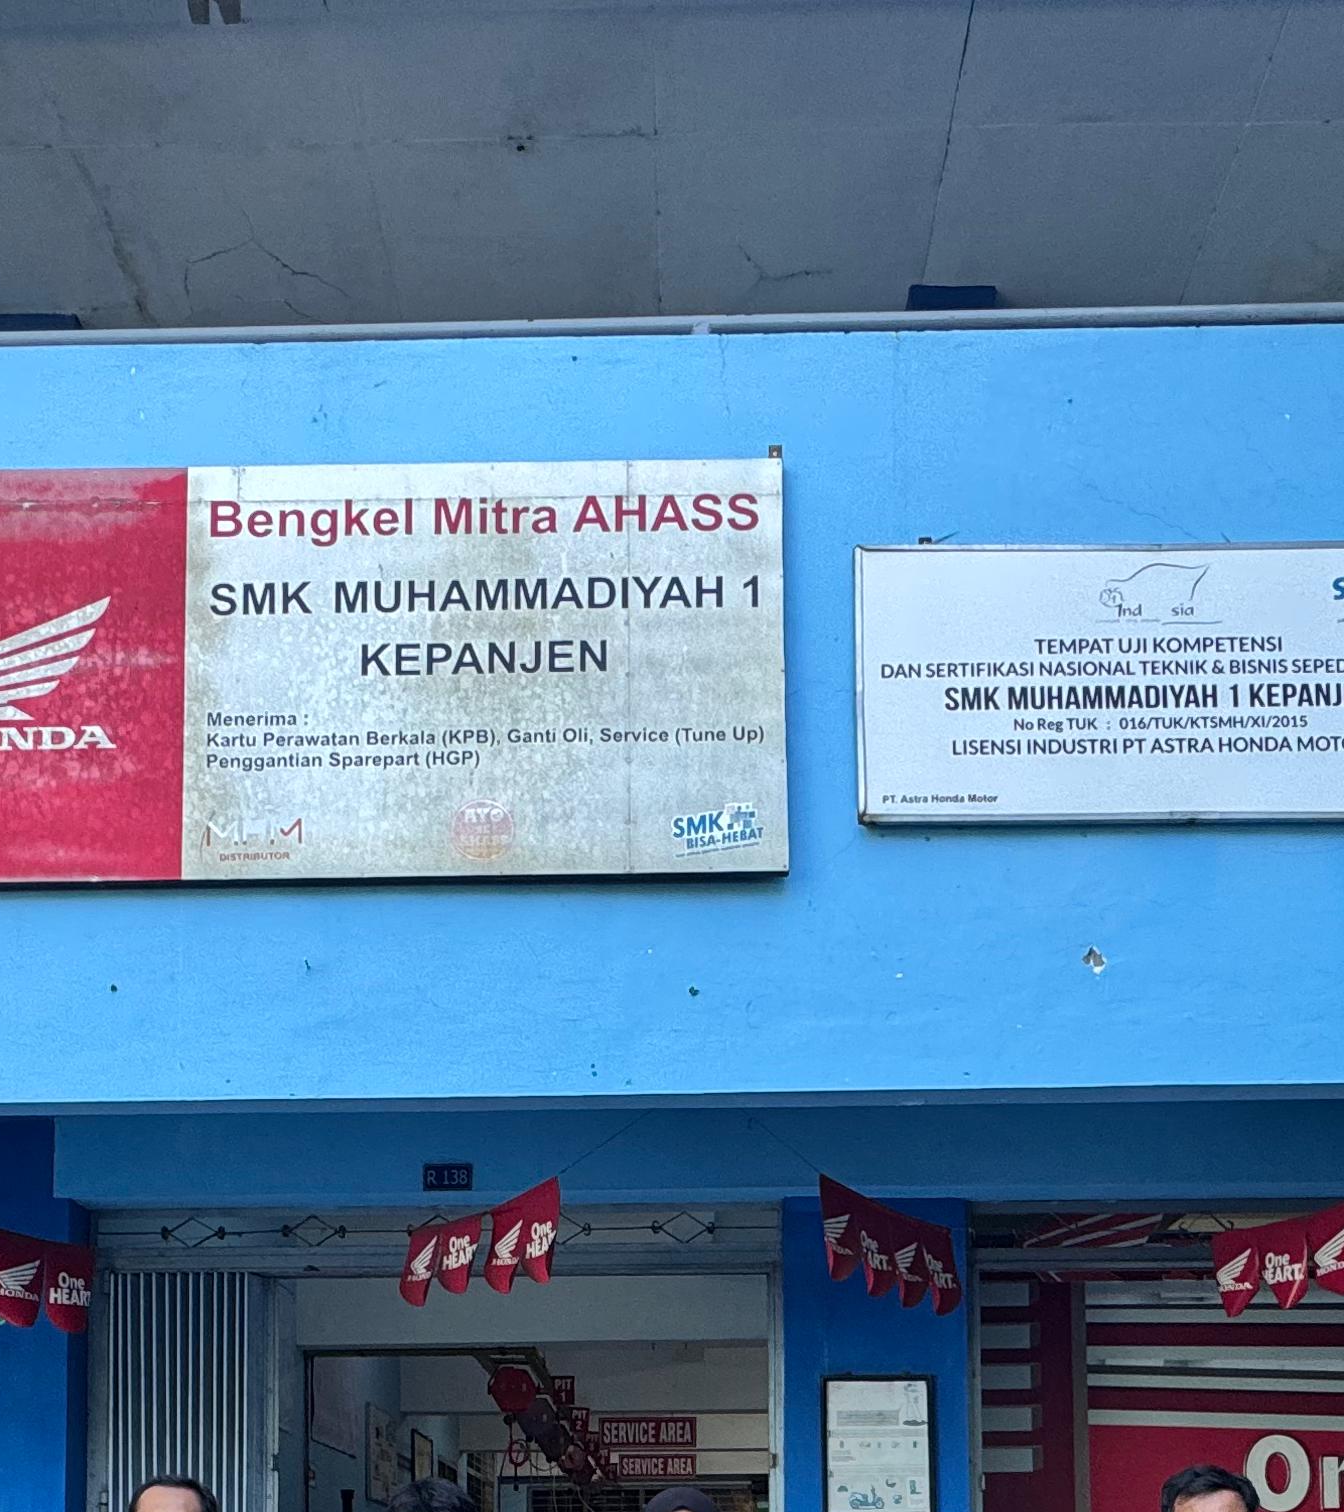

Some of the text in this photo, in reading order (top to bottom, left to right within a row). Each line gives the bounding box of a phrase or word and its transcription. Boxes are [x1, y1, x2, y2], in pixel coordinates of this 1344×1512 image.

[208, 493, 760, 546] Bengkel Mitra AHASS
[210, 576, 761, 616] SMK MUHAMMADIYAH 1
[1034, 636, 1283, 654] TEMPAT UJI KOMPETENSI
[360, 640, 608, 676] KEPANJEN
[881, 663, 921, 679] DAN
[926, 662, 1034, 678] SERTIFIKASI
[1039, 660, 1136, 677] NASIONAL
[1140, 660, 1207, 675] TEKNIK
[1211, 660, 1225, 674] &
[1229, 659, 1288, 674] BISNIS
[944, 686, 1000, 711] SMK
[1008, 684, 1218, 710] MUHAMMADIYAH
[1229, 684, 1239, 707] 1
[207, 712, 297, 726] Menerima
[1013, 718, 1034, 731] No
[1037, 718, 1064, 732] Reg
[1067, 717, 1098, 730] TUK
[1119, 715, 1308, 731] 016/TUK/KTSMH/XI/2015
[207, 725, 765, 747] Kartu Perawatan Berkala (KPB), Ganti Oli, Service (Tune Up)
[952, 739, 1021, 755] LISENSI
[1027, 738, 1117, 754] INDUSTRI
[1122, 738, 1147, 753] PT
[1150, 737, 1214, 753] ASTRA
[1218, 736, 1293, 752] HONDA
[207, 750, 480, 771] Penggantian Sparepart (HGP)
[900, 795, 929, 804] Astra
[931, 794, 965, 803] Honda
[967, 794, 998, 803] Motor
[673, 811, 724, 838] SMK
[686, 827, 764, 849] BISA-HEBAT
[219, 851, 291, 862] DISTRIBUTOR
[427, 1169, 468, 1186] R 138
[531, 1220, 553, 1241] One
[449, 1235, 470, 1253] One
[1265, 1252, 1290, 1268] One
[58, 1271, 85, 1290] One
[555, 1379, 572, 1390] PIT
[572, 1410, 588, 1420] PIT
[603, 1421, 692, 1443] SERVICE AREA
[622, 1458, 664, 1475] SERVICE
[666, 1457, 693, 1475] AREA
